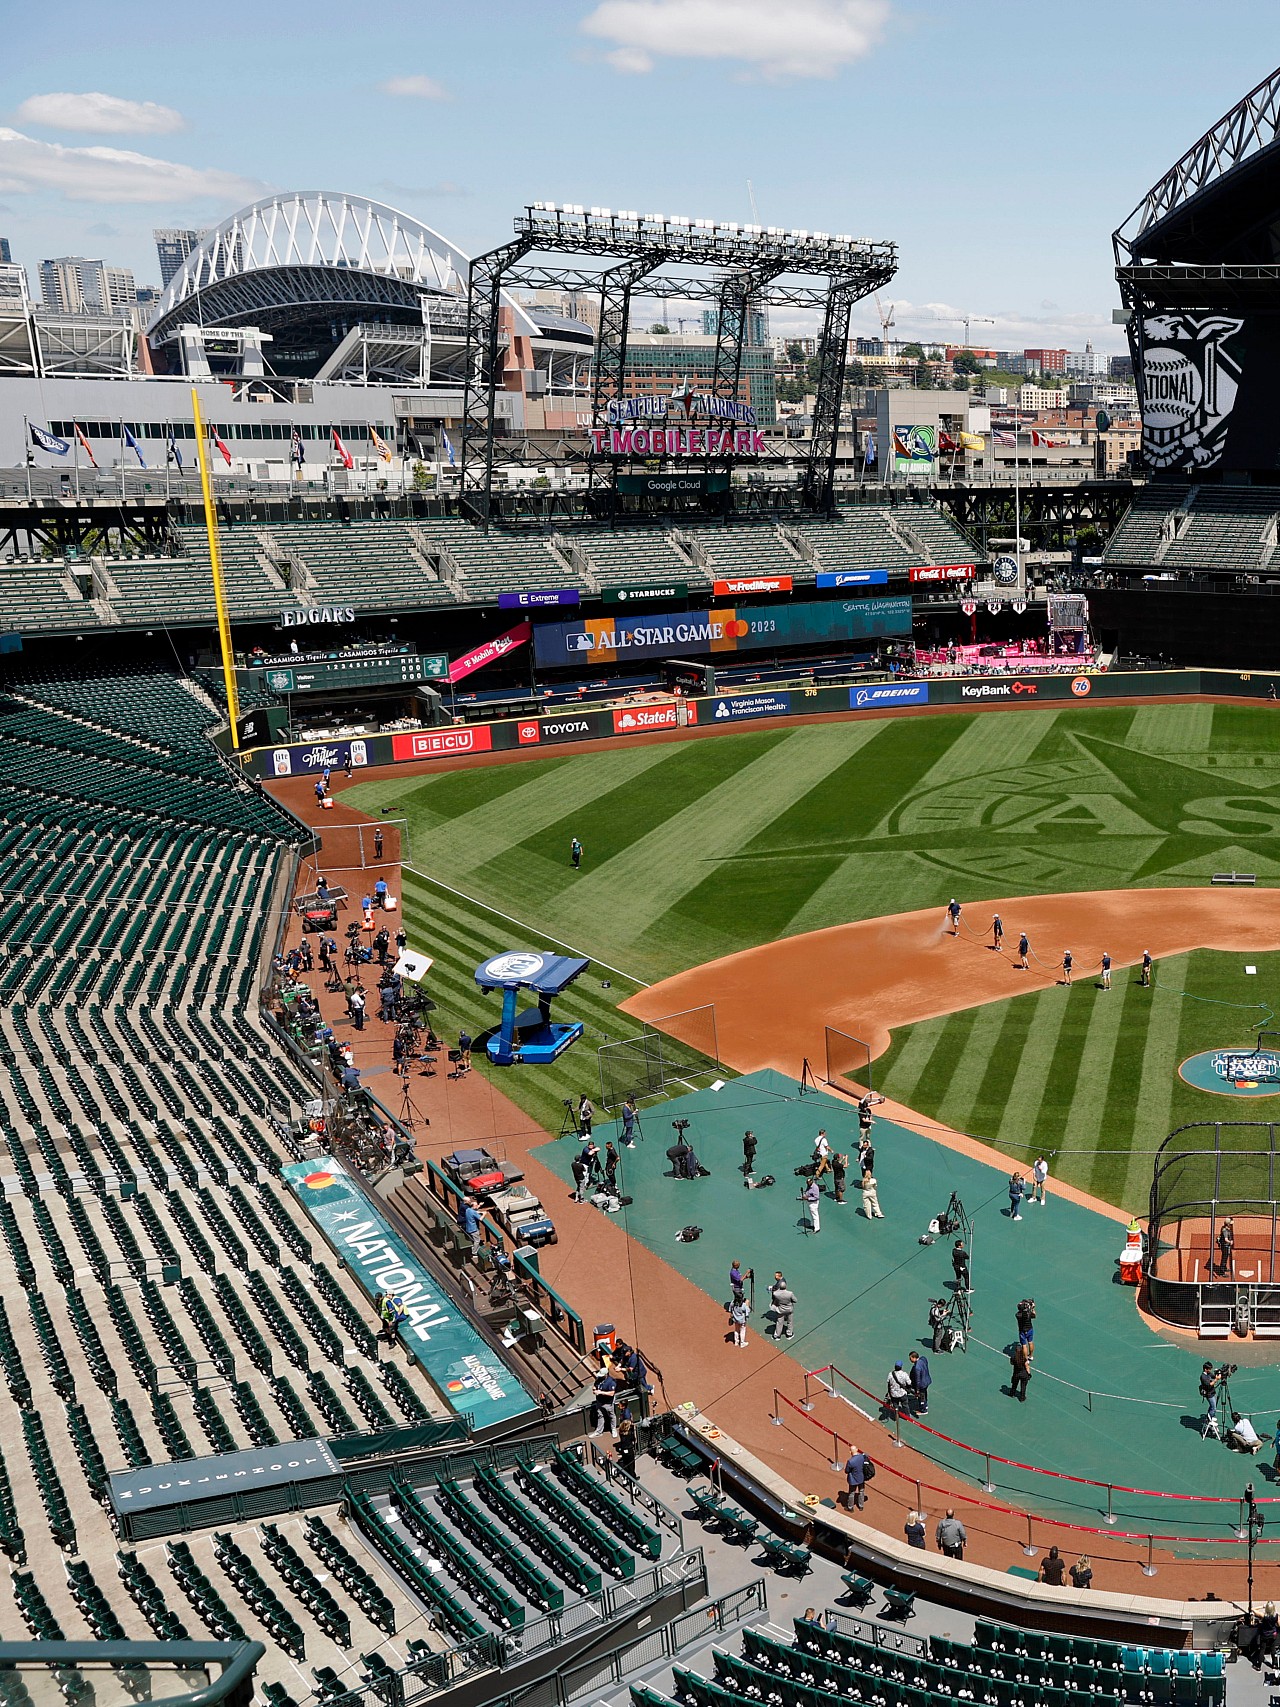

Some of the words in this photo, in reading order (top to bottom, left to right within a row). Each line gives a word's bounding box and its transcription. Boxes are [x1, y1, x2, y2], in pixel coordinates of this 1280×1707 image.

[231, 331, 244, 339] THE
[608, 395, 666, 423] SEATTLE
[699, 394, 757, 425] MARINERS
[704, 429, 767, 454] PARK
[647, 480, 677, 492] Google
[678, 480, 701, 490] Cloud
[531, 594, 559, 603] Extreme
[629, 588, 676, 598] STARBUCKS
[676, 622, 724, 643] GAME
[751, 619, 776, 633] 2023
[263, 655, 305, 665] CASAMIGOS
[305, 653, 327, 662] Tequila
[338, 649, 377, 659] CASAMIGOS
[378, 648, 398, 656] Tequila
[471, 647, 494, 664] Mobile
[296, 674, 314, 682] Visitors
[1239, 674, 1251, 682] 401
[871, 687, 920, 698] BOEING
[962, 685, 1010, 698] KeyBank
[1074, 681, 1088, 692] 76
[804, 689, 817, 697] 376
[731, 699, 753, 708] Virginia
[754, 697, 775, 705] Mason
[732, 705, 763, 715] Franciscan
[764, 703, 786, 711] Health
[543, 721, 589, 735] TOYOTA
[418, 731, 473, 752] BECU
[352, 744, 365, 753] Lite
[243, 753, 253, 764] 331
[275, 753, 289, 763] Lite
[302, 748, 338, 767] Miller
[320, 757, 338, 767] TIME
[338, 1217, 450, 1342] NATIONAL
[481, 1379, 507, 1401] GAME
[118, 1457, 318, 1500] MUCKLESHOOT
